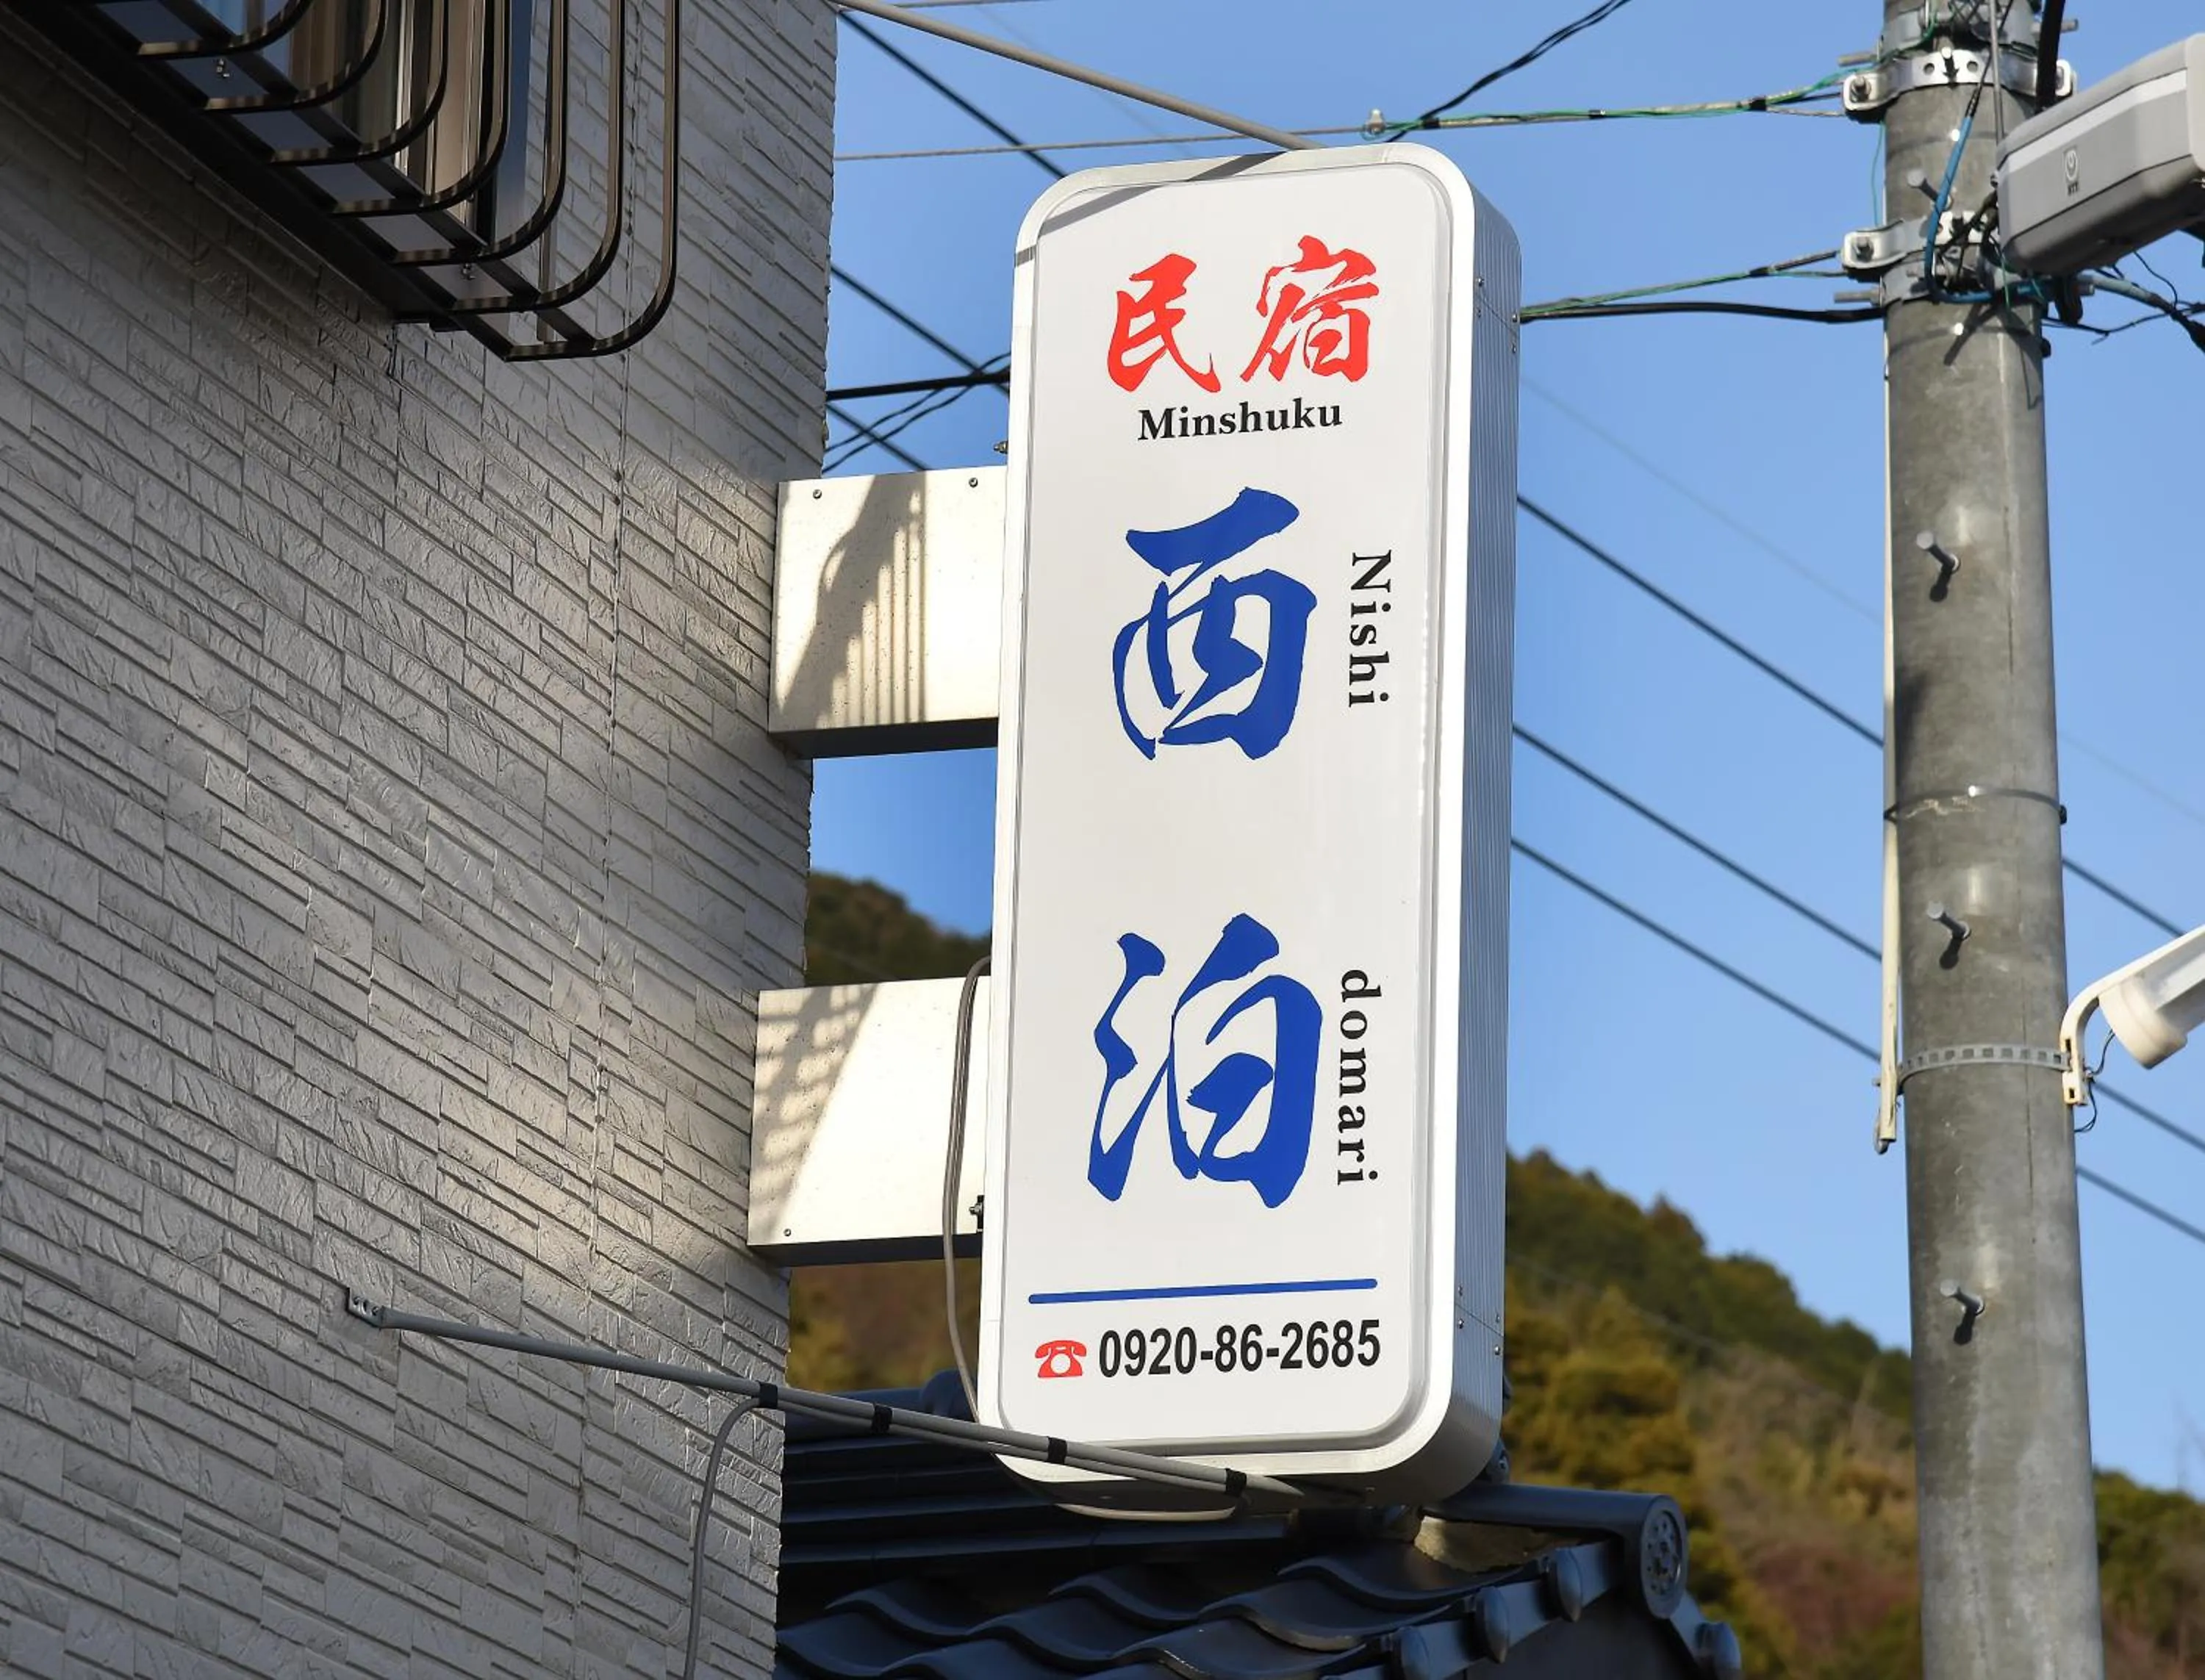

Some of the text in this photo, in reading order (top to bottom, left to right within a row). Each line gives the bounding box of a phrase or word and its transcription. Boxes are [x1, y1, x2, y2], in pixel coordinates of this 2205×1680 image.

[1107, 234, 1380, 394] 民宿
[1138, 398, 1342, 441] Minshuku
[1088, 487, 1322, 1208] 西泊
[1337, 550, 1392, 1185] Nishi domari
[1099, 1318, 1380, 1378] 0920-86-2685
